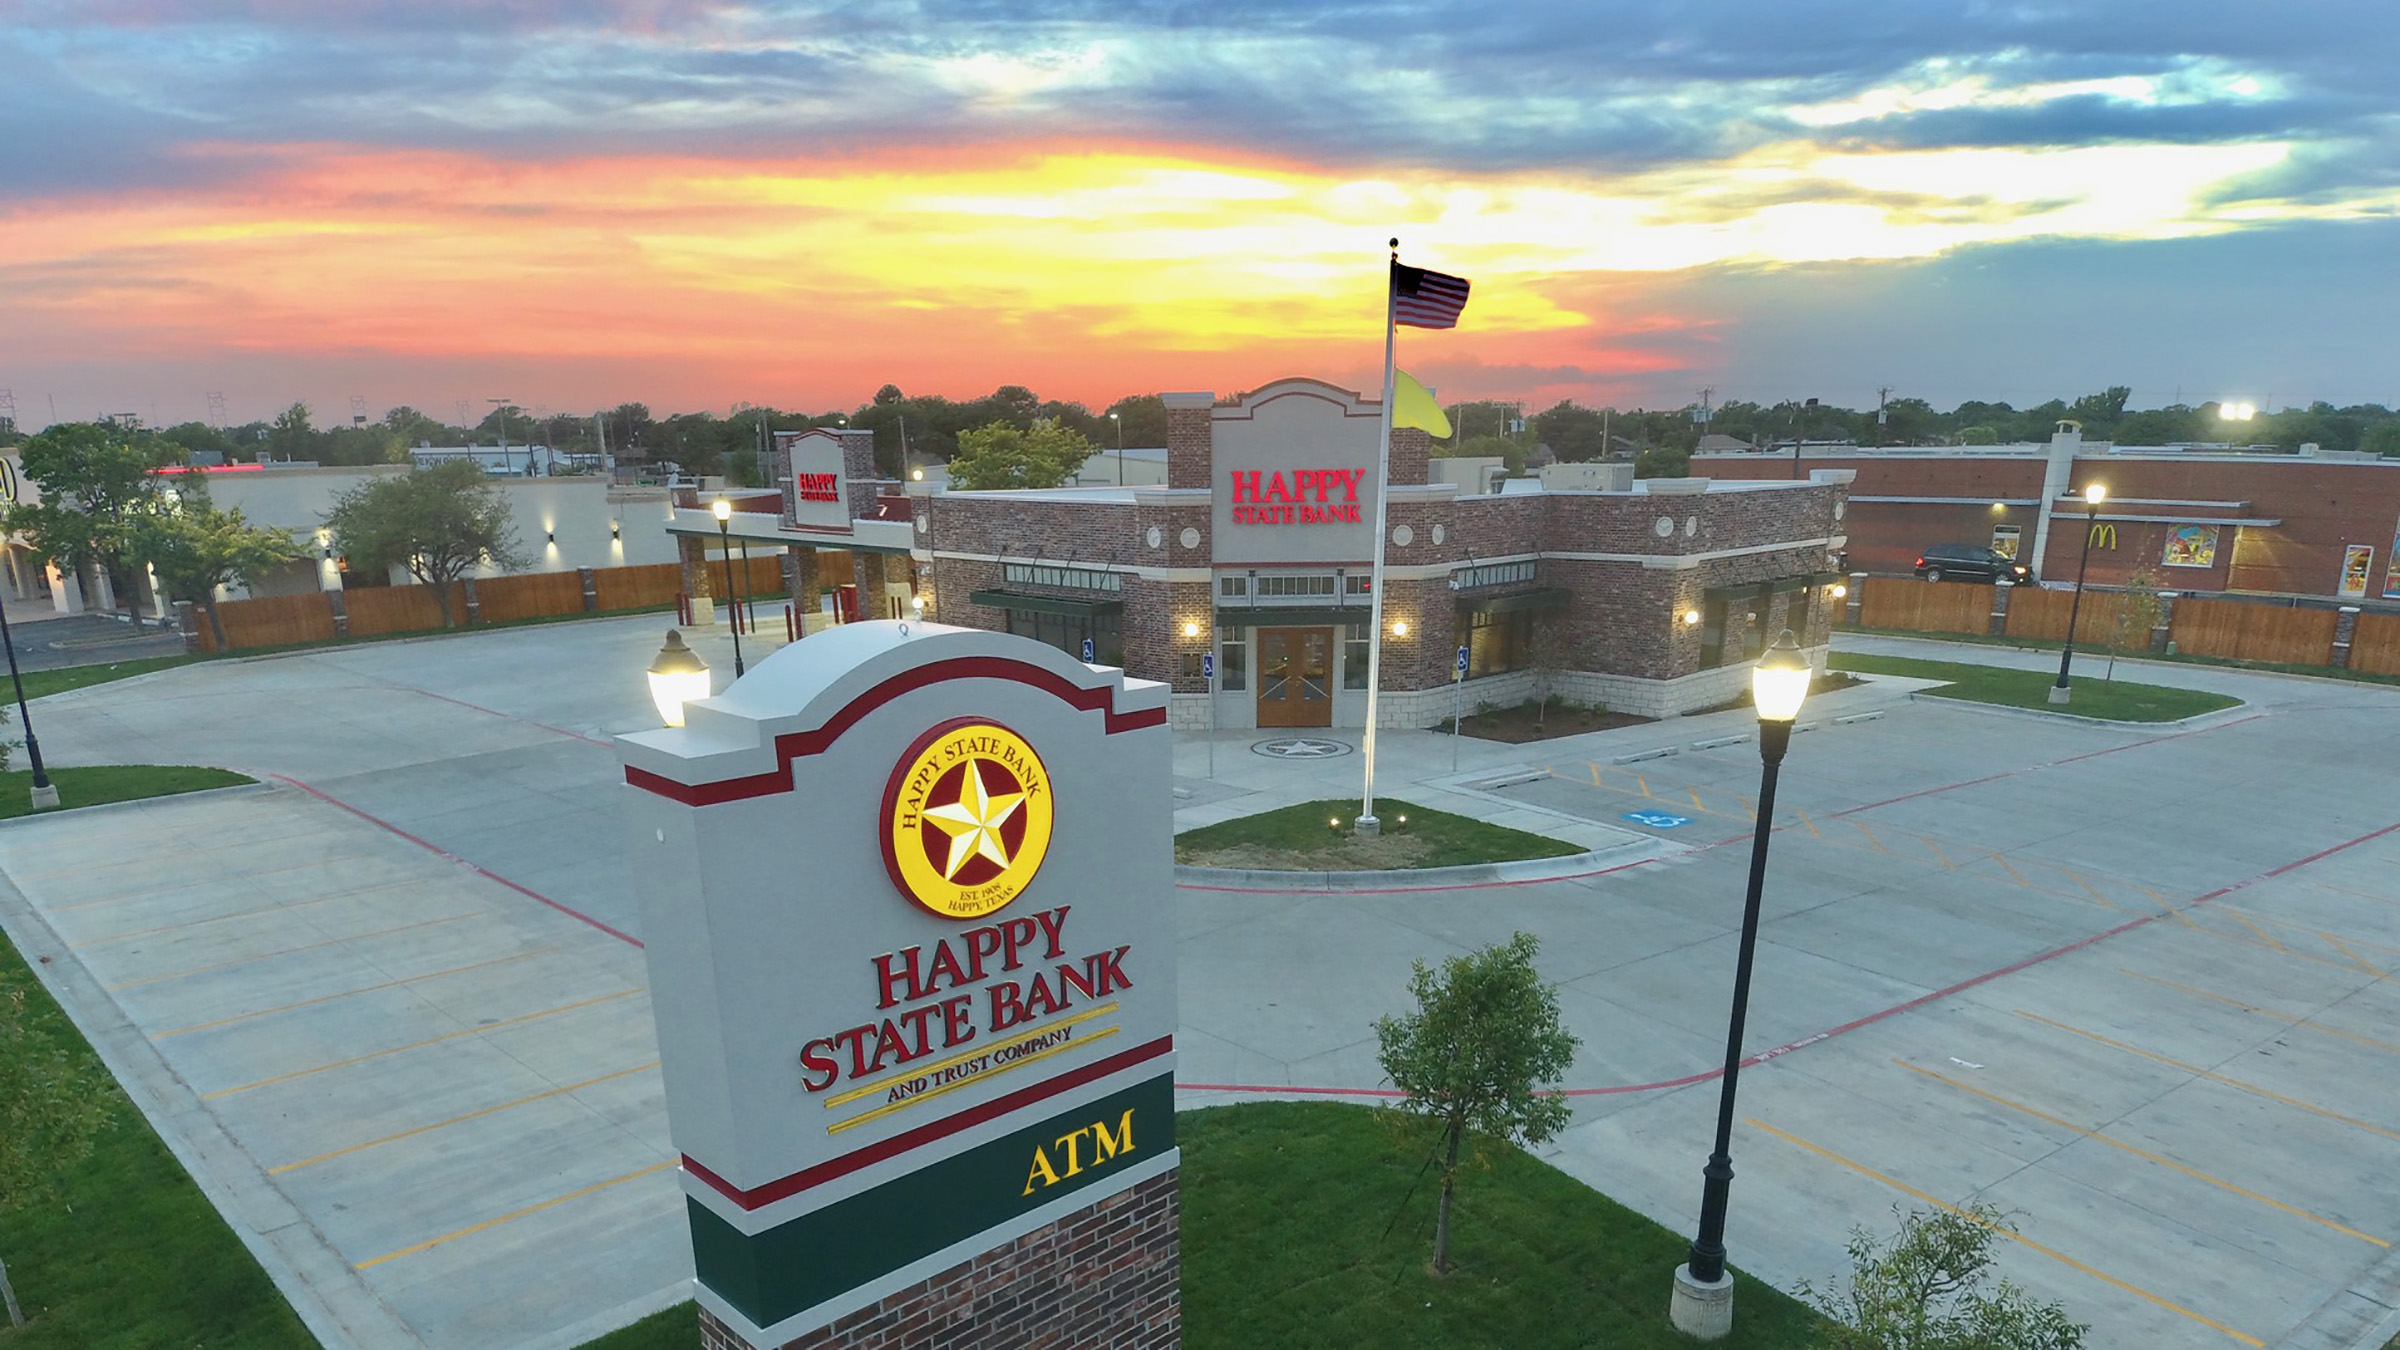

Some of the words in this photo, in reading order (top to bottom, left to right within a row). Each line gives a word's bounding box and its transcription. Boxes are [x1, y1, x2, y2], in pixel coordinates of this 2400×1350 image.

[799, 473, 838, 491] HAPPY
[1231, 469, 1366, 503] HAPPY
[1232, 505, 1296, 525] STATE
[1299, 504, 1363, 524] BANK
[902, 756, 942, 829] HAPPY
[944, 736, 1001, 762] STATE
[1003, 745, 1041, 799] BANK
[985, 884, 1014, 908] TEXAS
[871, 904, 1071, 1010] HAPPY
[800, 994, 977, 1093] STATE
[985, 944, 1134, 1034] BANK
[887, 1077, 928, 1103] AND
[931, 1055, 991, 1088] TRUST
[993, 1026, 1073, 1065] COMPANY
[1021, 1107, 1136, 1197] ATM
